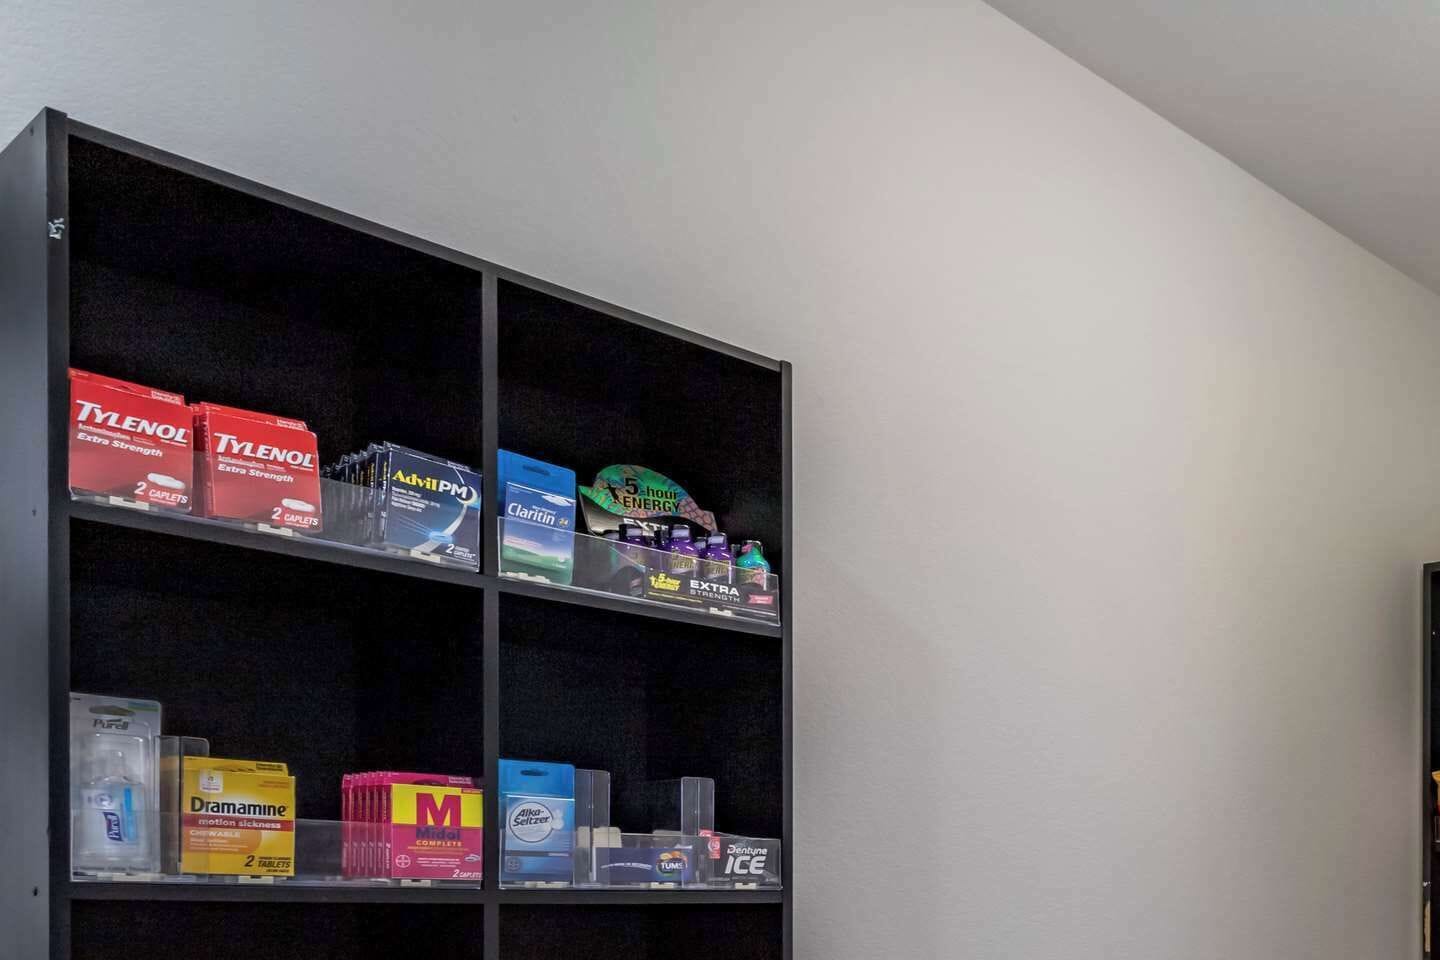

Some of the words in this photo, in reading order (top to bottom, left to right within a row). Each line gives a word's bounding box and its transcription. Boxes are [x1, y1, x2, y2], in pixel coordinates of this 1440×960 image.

[76, 400, 189, 443] TYLENOL
[77, 432, 109, 446] Extra
[112, 440, 162, 457] Strength
[214, 432, 315, 468] TYLENOL
[218, 464, 246, 476] Extra
[248, 469, 294, 483] Strength
[134, 482, 145, 495] 2
[149, 488, 187, 504] CAPLETS
[392, 470, 438, 491] Advil
[438, 481, 468, 499] PM
[623, 496, 680, 512] ENERGY
[272, 507, 282, 519] 2
[285, 513, 318, 526] CAPLETS
[508, 503, 555, 526] Claritin
[690, 580, 739, 596] EXTRA
[690, 589, 740, 602] STRENGTH
[191, 796, 287, 817] Dramamine
[416, 793, 461, 827] M
[198, 819, 236, 828] motion
[239, 820, 281, 829] sickness
[513, 816, 550, 827] Seltzer
[727, 845, 767, 855] Dentyne
[245, 855, 255, 867] 2
[258, 860, 290, 868] TABLETS
[661, 861, 683, 870] TUMS
[725, 856, 766, 874] ICE
[453, 869, 459, 878] 2
